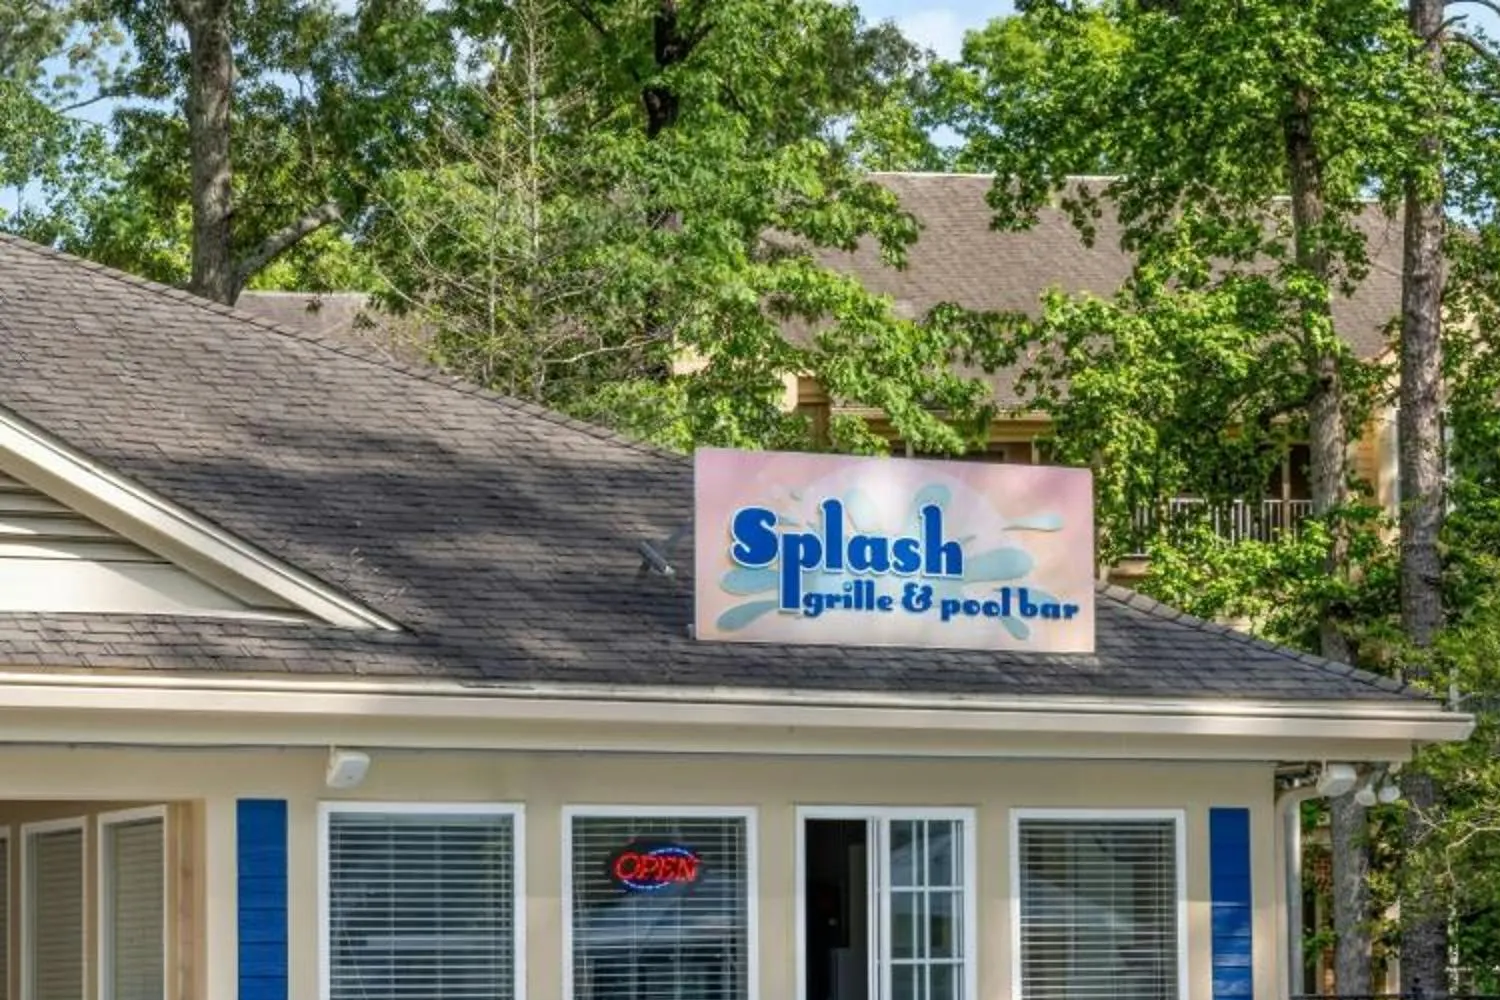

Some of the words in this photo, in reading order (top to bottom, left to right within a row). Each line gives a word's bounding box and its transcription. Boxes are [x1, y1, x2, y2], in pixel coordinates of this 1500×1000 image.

[731, 498, 964, 611] Splash
[802, 579, 893, 617] grille
[902, 582, 933, 613] &
[940, 586, 1011, 622] pool
[1018, 587, 1080, 620] bar
[614, 852, 701, 882] OPEN
